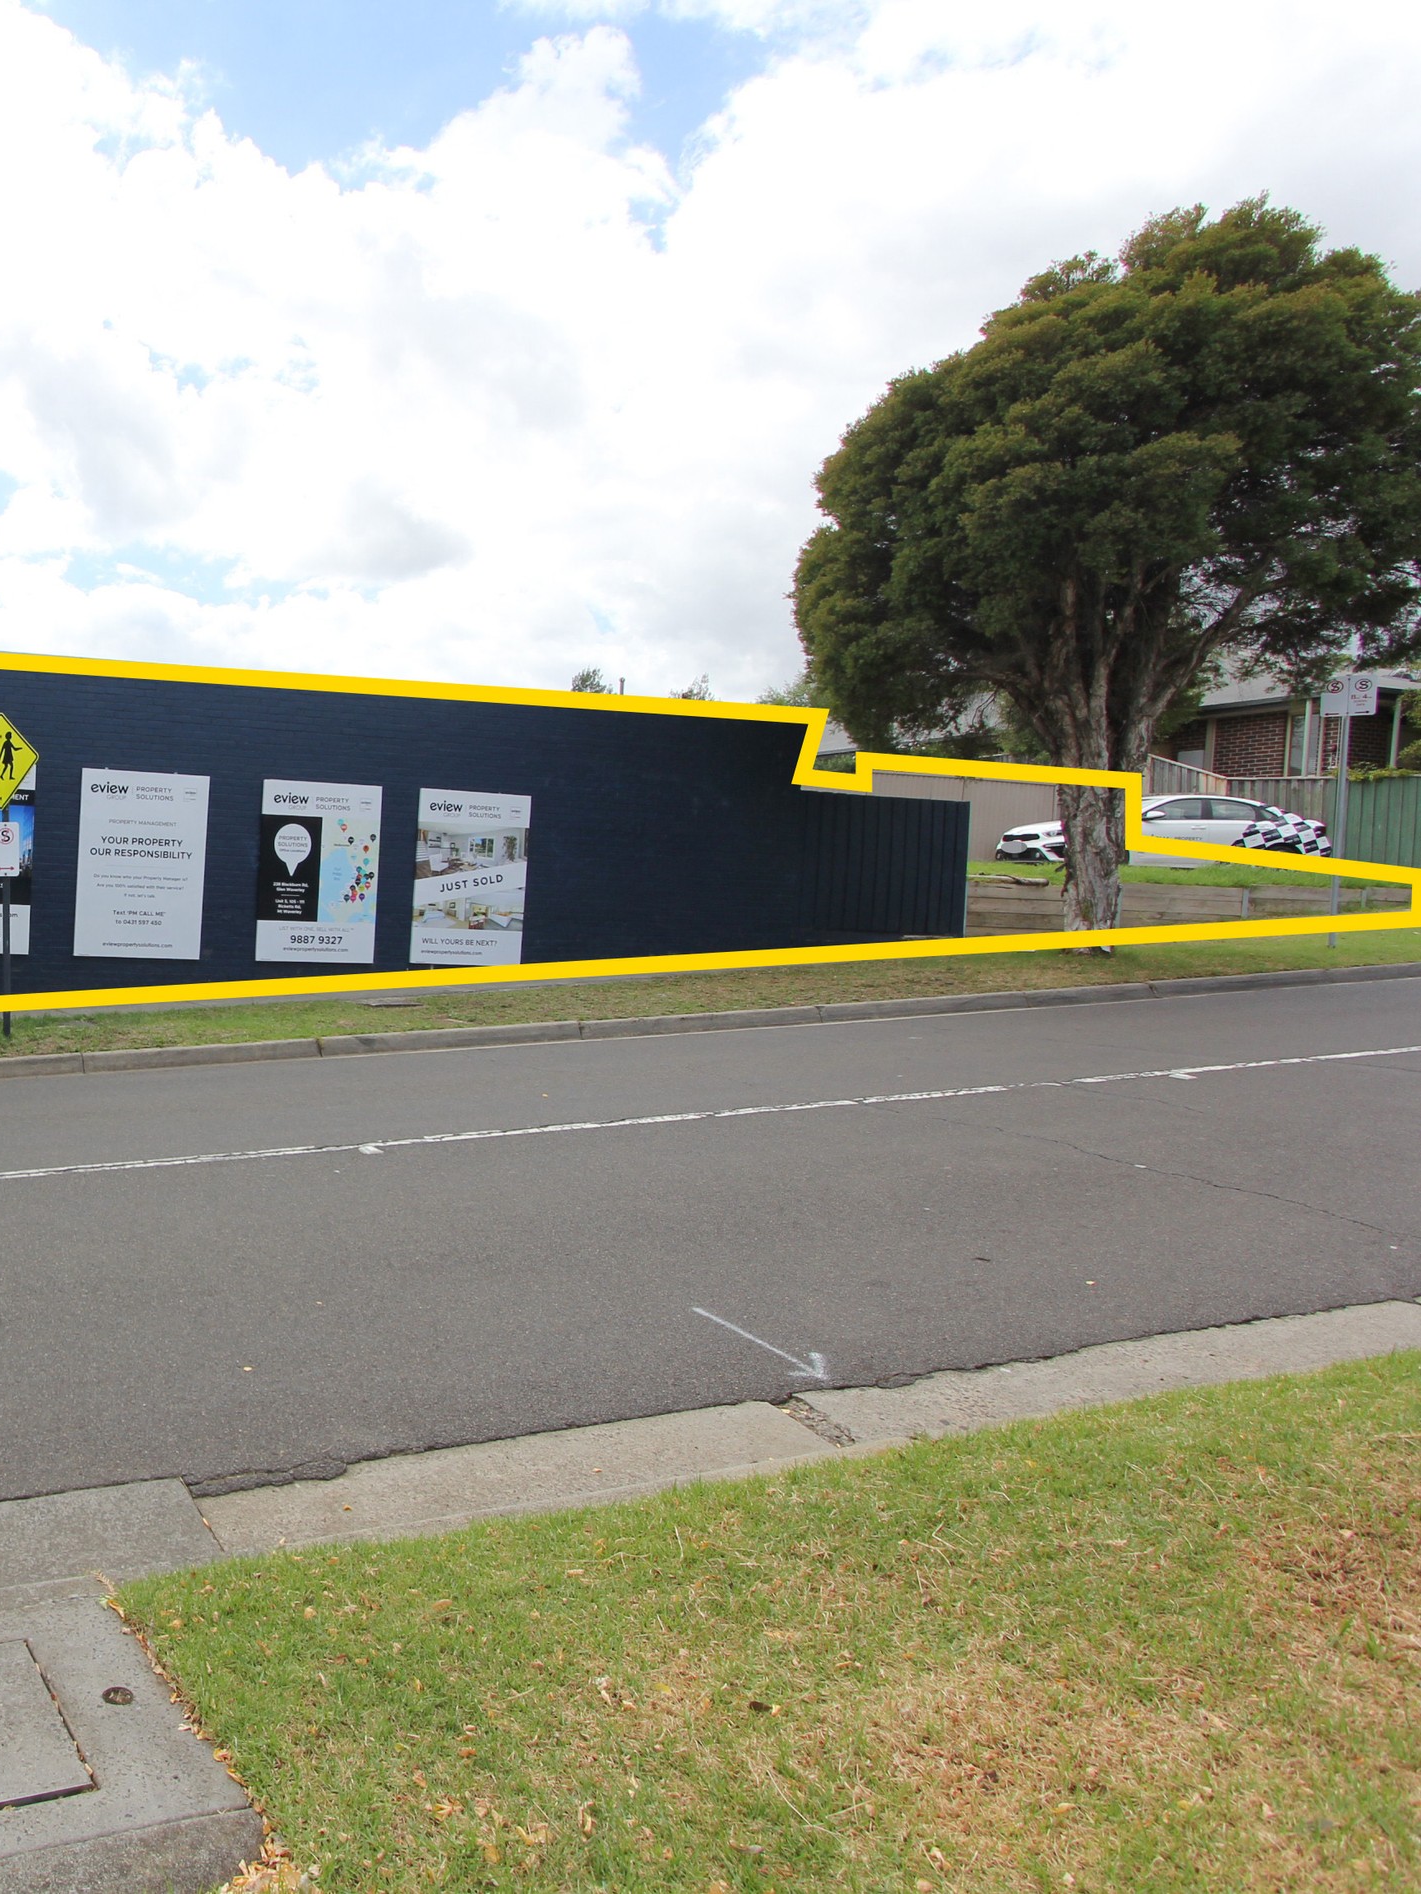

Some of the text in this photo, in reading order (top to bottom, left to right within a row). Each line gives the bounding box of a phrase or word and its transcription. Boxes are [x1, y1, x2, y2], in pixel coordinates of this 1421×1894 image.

[90, 782, 129, 794] eview
[274, 792, 309, 804] eview
[430, 801, 463, 812] eview
[100, 836, 183, 847] YOUR PROPERTY
[90, 848, 192, 859] OUR RESPONSIBILITY
[440, 874, 504, 892] JUST SOLD
[290, 935, 343, 944] 9887 9327
